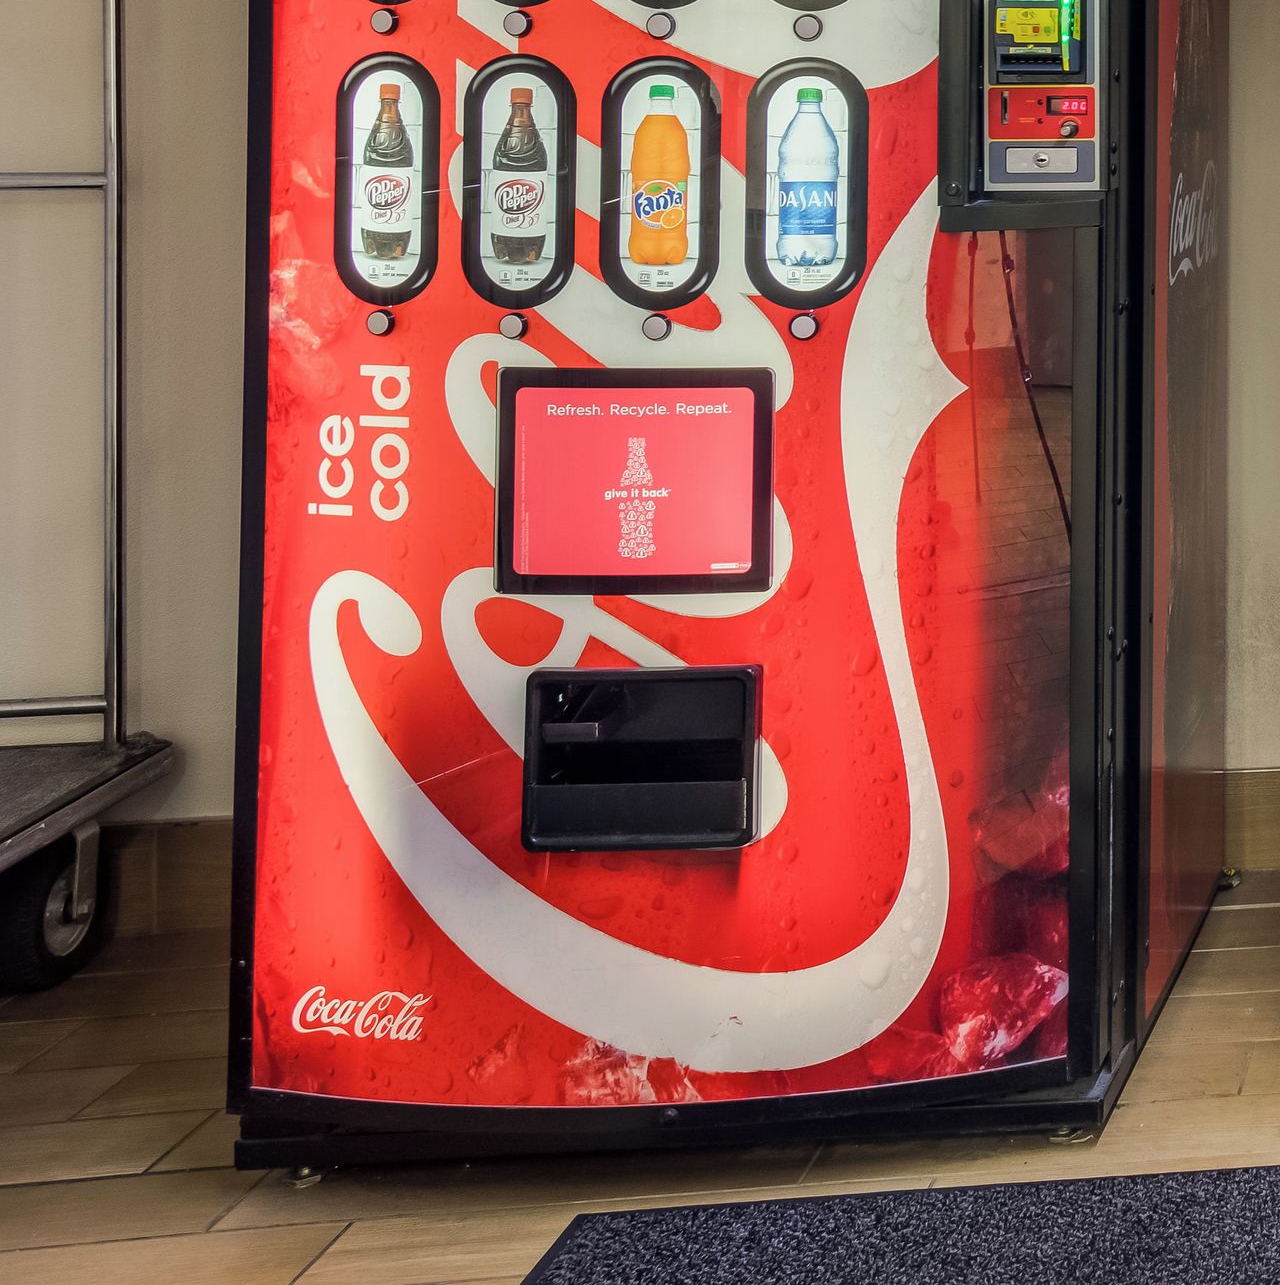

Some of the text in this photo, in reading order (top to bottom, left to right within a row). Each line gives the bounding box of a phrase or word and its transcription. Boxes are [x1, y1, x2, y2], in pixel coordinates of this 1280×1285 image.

[371, 183, 405, 206] Pepper
[382, 179, 397, 193] Dr
[513, 183, 529, 197] Dr
[501, 187, 539, 211] Pepper
[634, 188, 684, 219] Fanta
[779, 186, 838, 210] DASANI
[374, 210, 388, 220] Diet
[505, 214, 520, 225] Diet
[547, 402, 732, 418] Refresh. Recycle. Repeat.
[359, 363, 411, 522] cold
[307, 413, 355, 517] ice
[604, 488, 628, 501] give
[631, 488, 640, 499] it
[291, 984, 433, 1043] Coca-Cola
